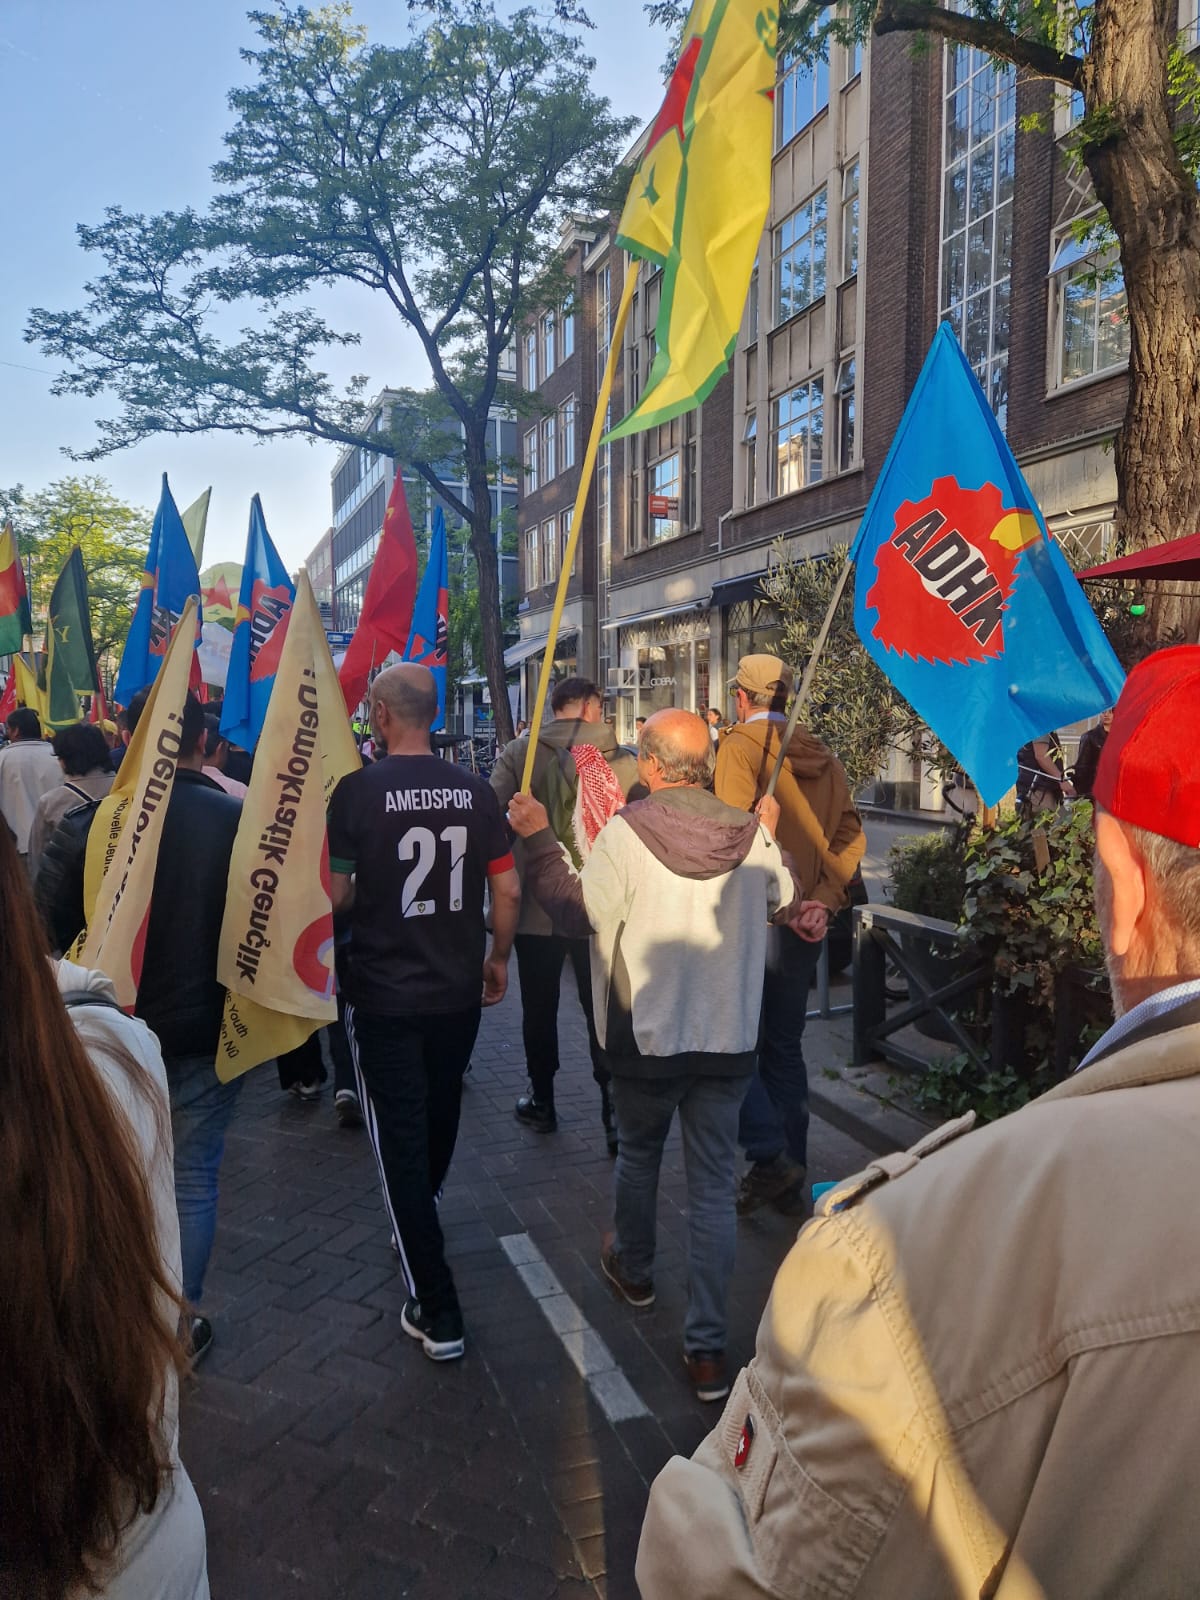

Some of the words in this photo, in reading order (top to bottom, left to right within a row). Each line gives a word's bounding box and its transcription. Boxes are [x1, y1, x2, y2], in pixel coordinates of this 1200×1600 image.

[385, 788, 473, 813] AMEDSPOR
[397, 825, 468, 919] 21
[228, 1003, 249, 1038] Youth
